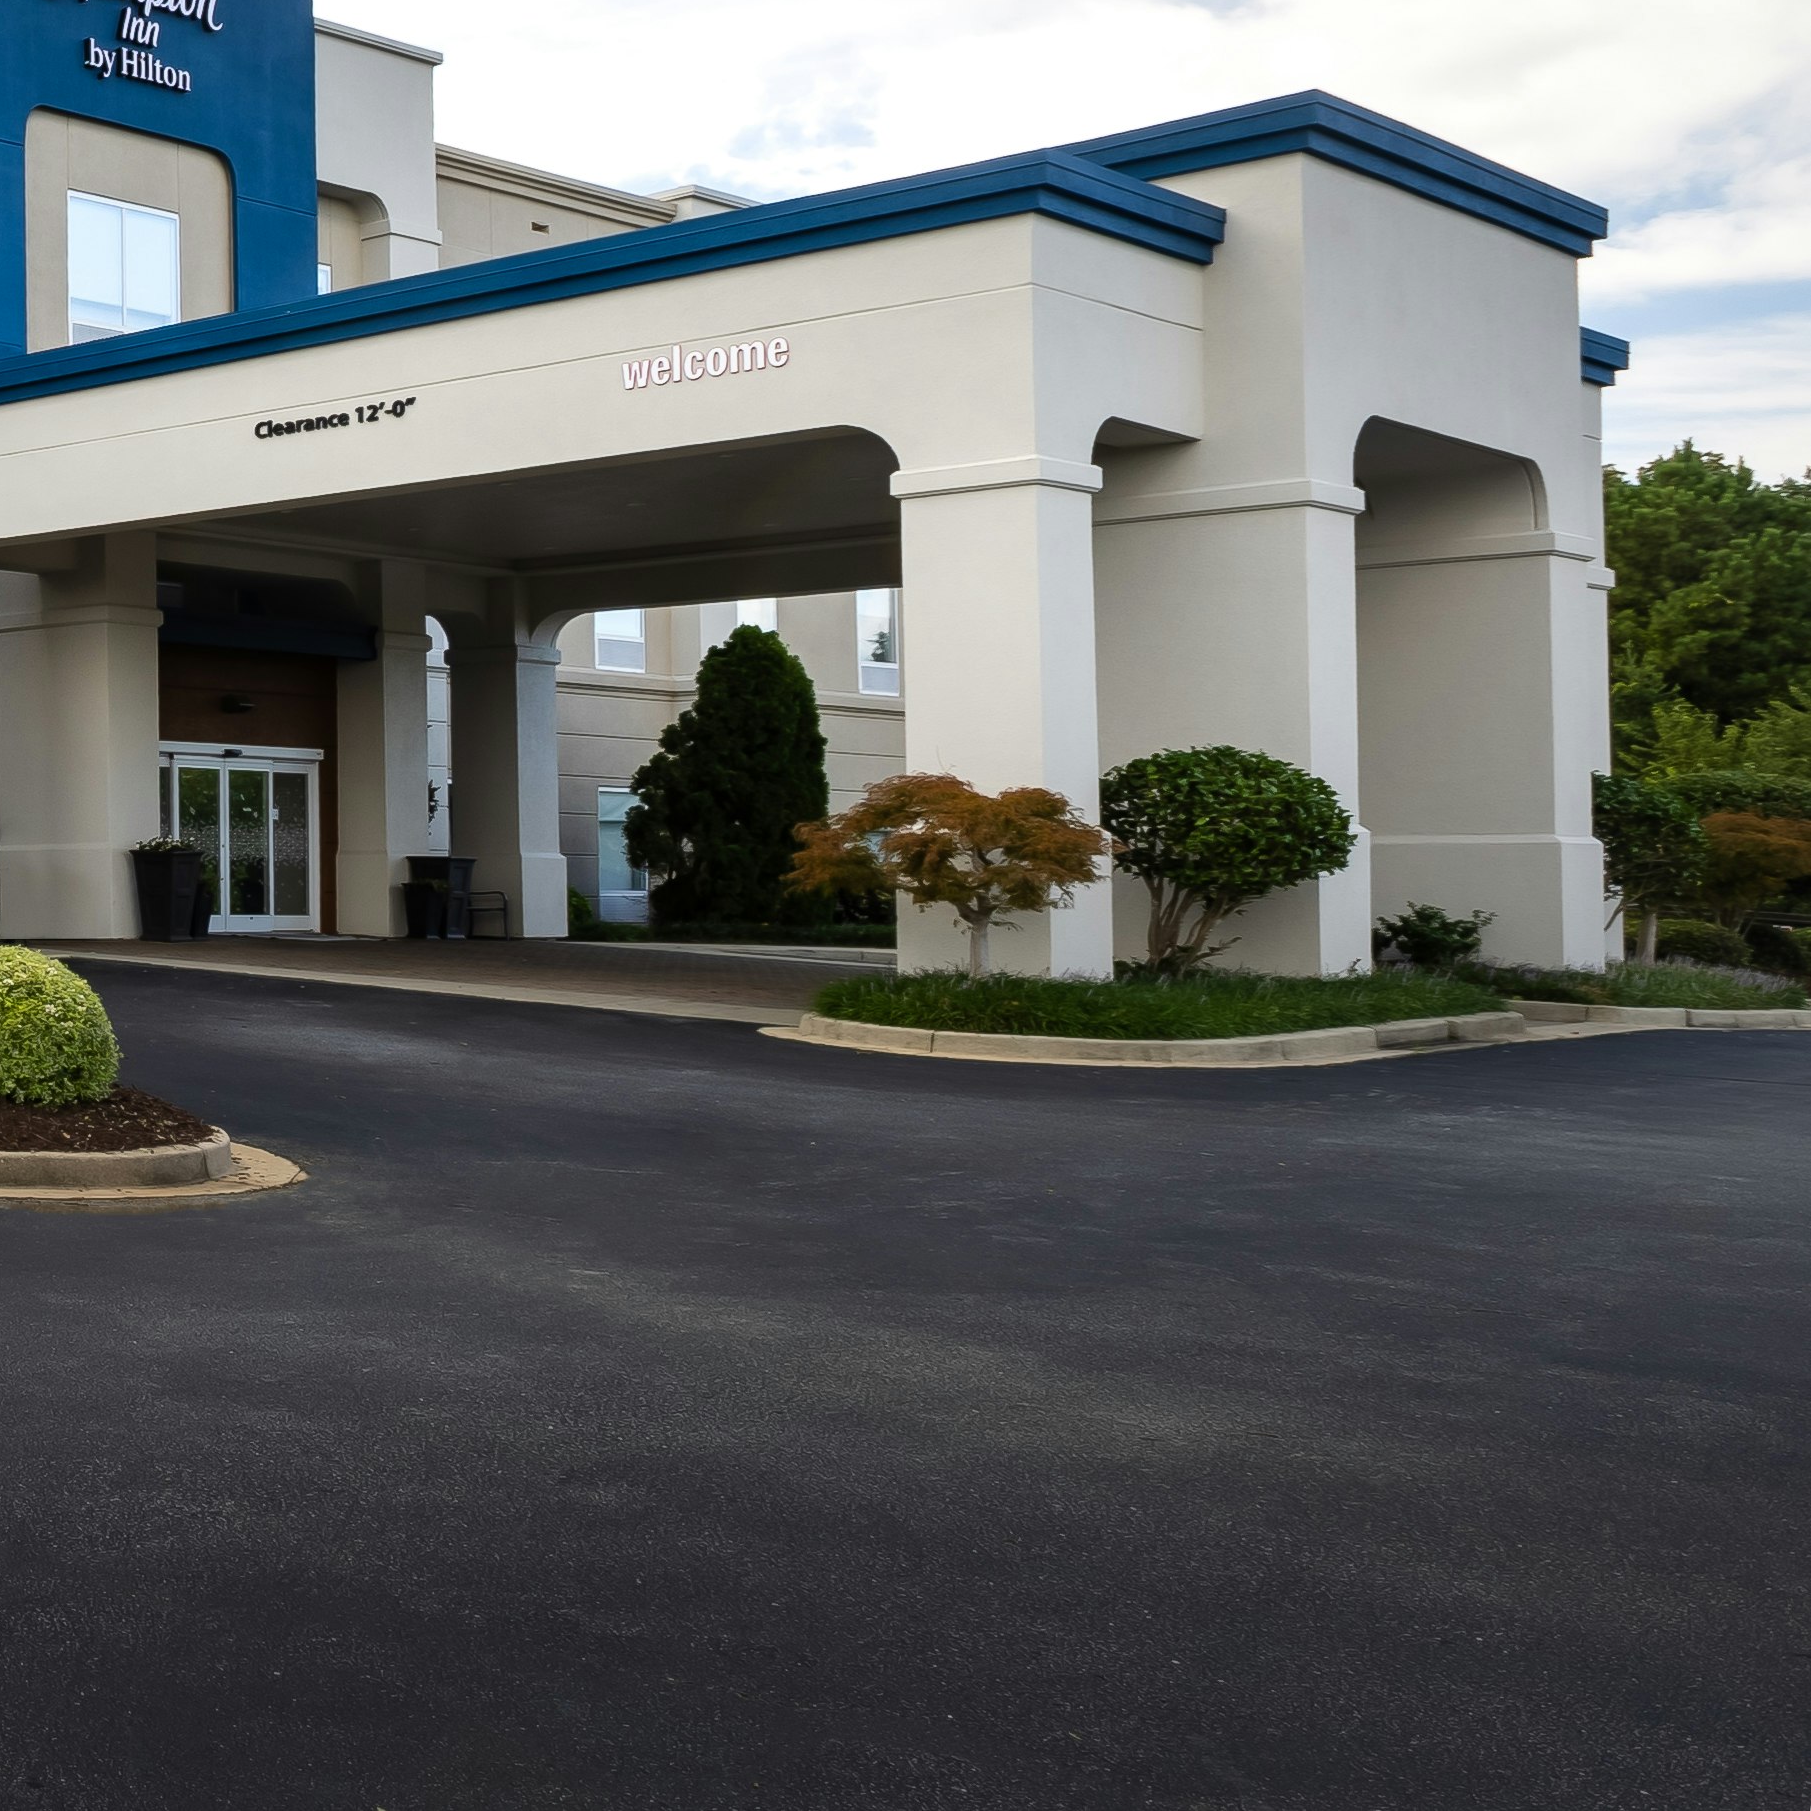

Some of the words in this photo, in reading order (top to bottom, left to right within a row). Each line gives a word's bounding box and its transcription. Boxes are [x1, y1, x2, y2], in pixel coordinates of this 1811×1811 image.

[121, 7, 160, 48] Inn
[88, 37, 117, 78] by
[120, 47, 192, 92] Hilton
[621, 336, 790, 391] welcome
[254, 413, 350, 439] Clearance
